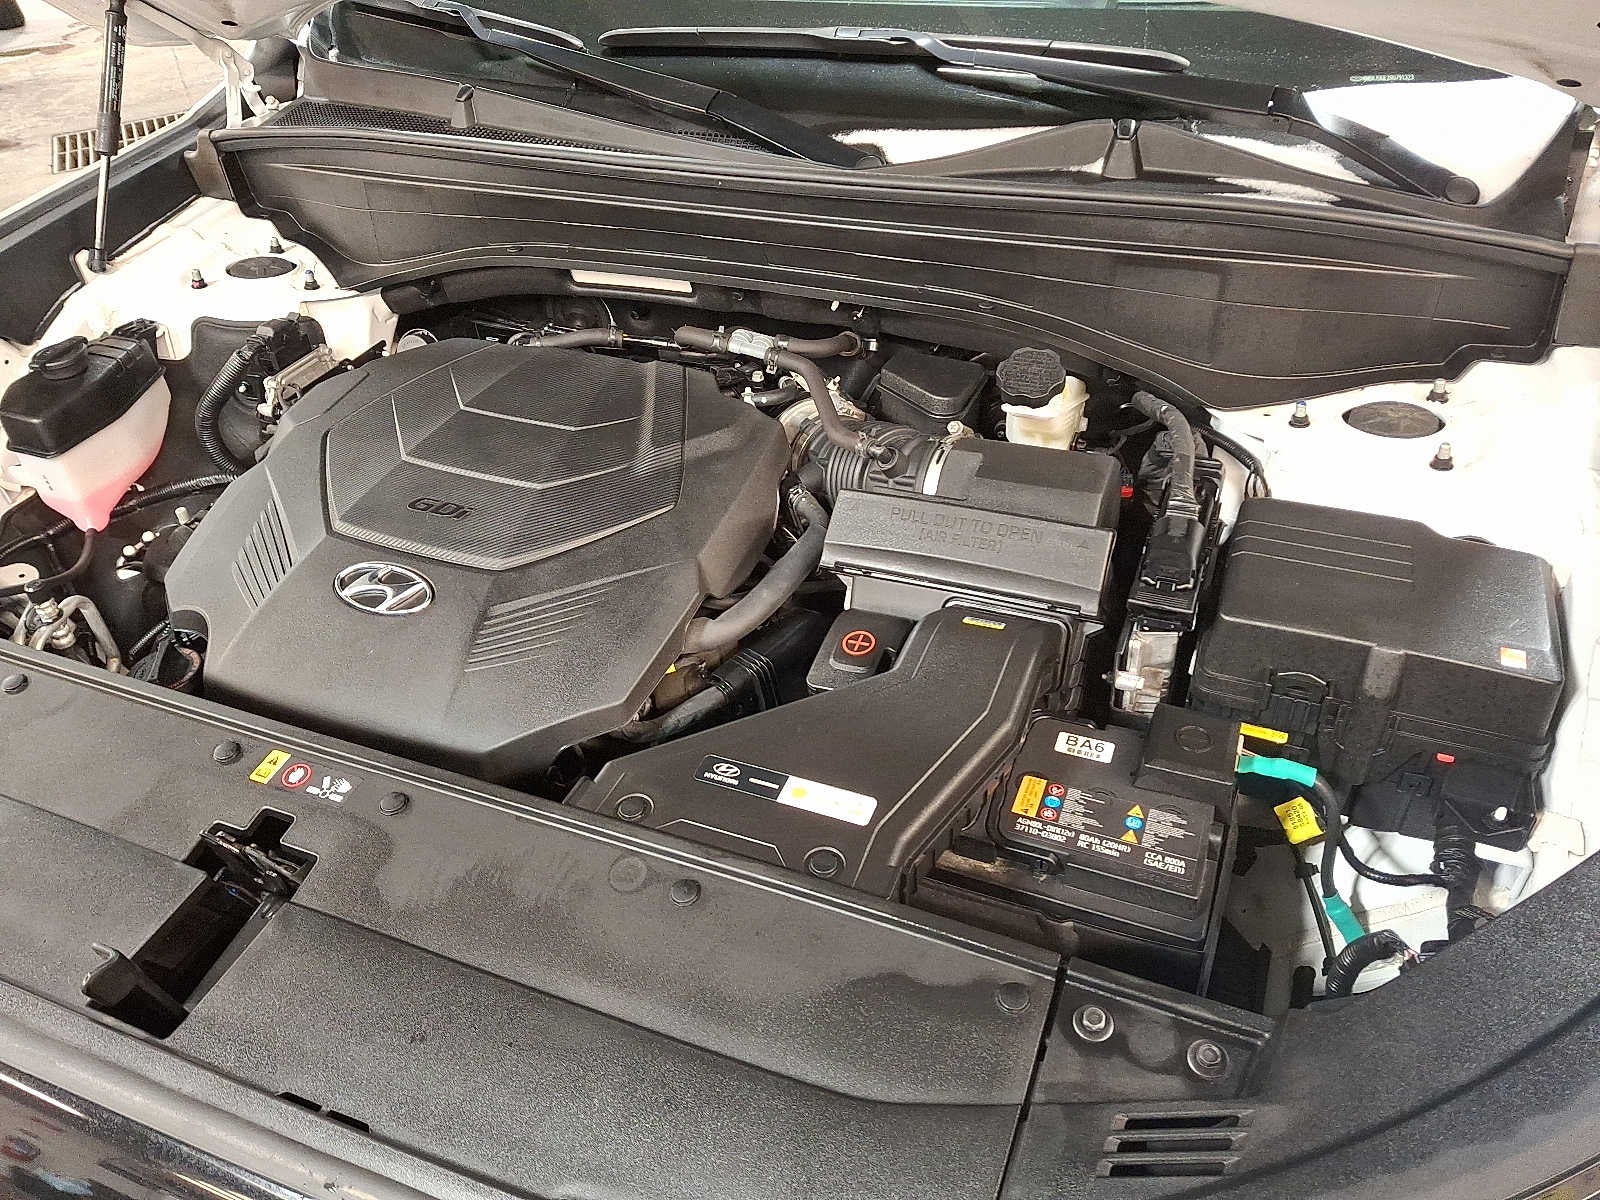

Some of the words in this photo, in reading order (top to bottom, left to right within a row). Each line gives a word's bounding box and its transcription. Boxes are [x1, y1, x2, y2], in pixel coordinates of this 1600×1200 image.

[407, 498, 475, 520] GDi
[890, 505, 929, 525] PULL
[934, 513, 969, 530] OUT
[971, 518, 992, 534] TO
[996, 522, 1044, 545] OPEN
[1066, 735, 1105, 753] BA6
[1077, 840, 1090, 849] RC
